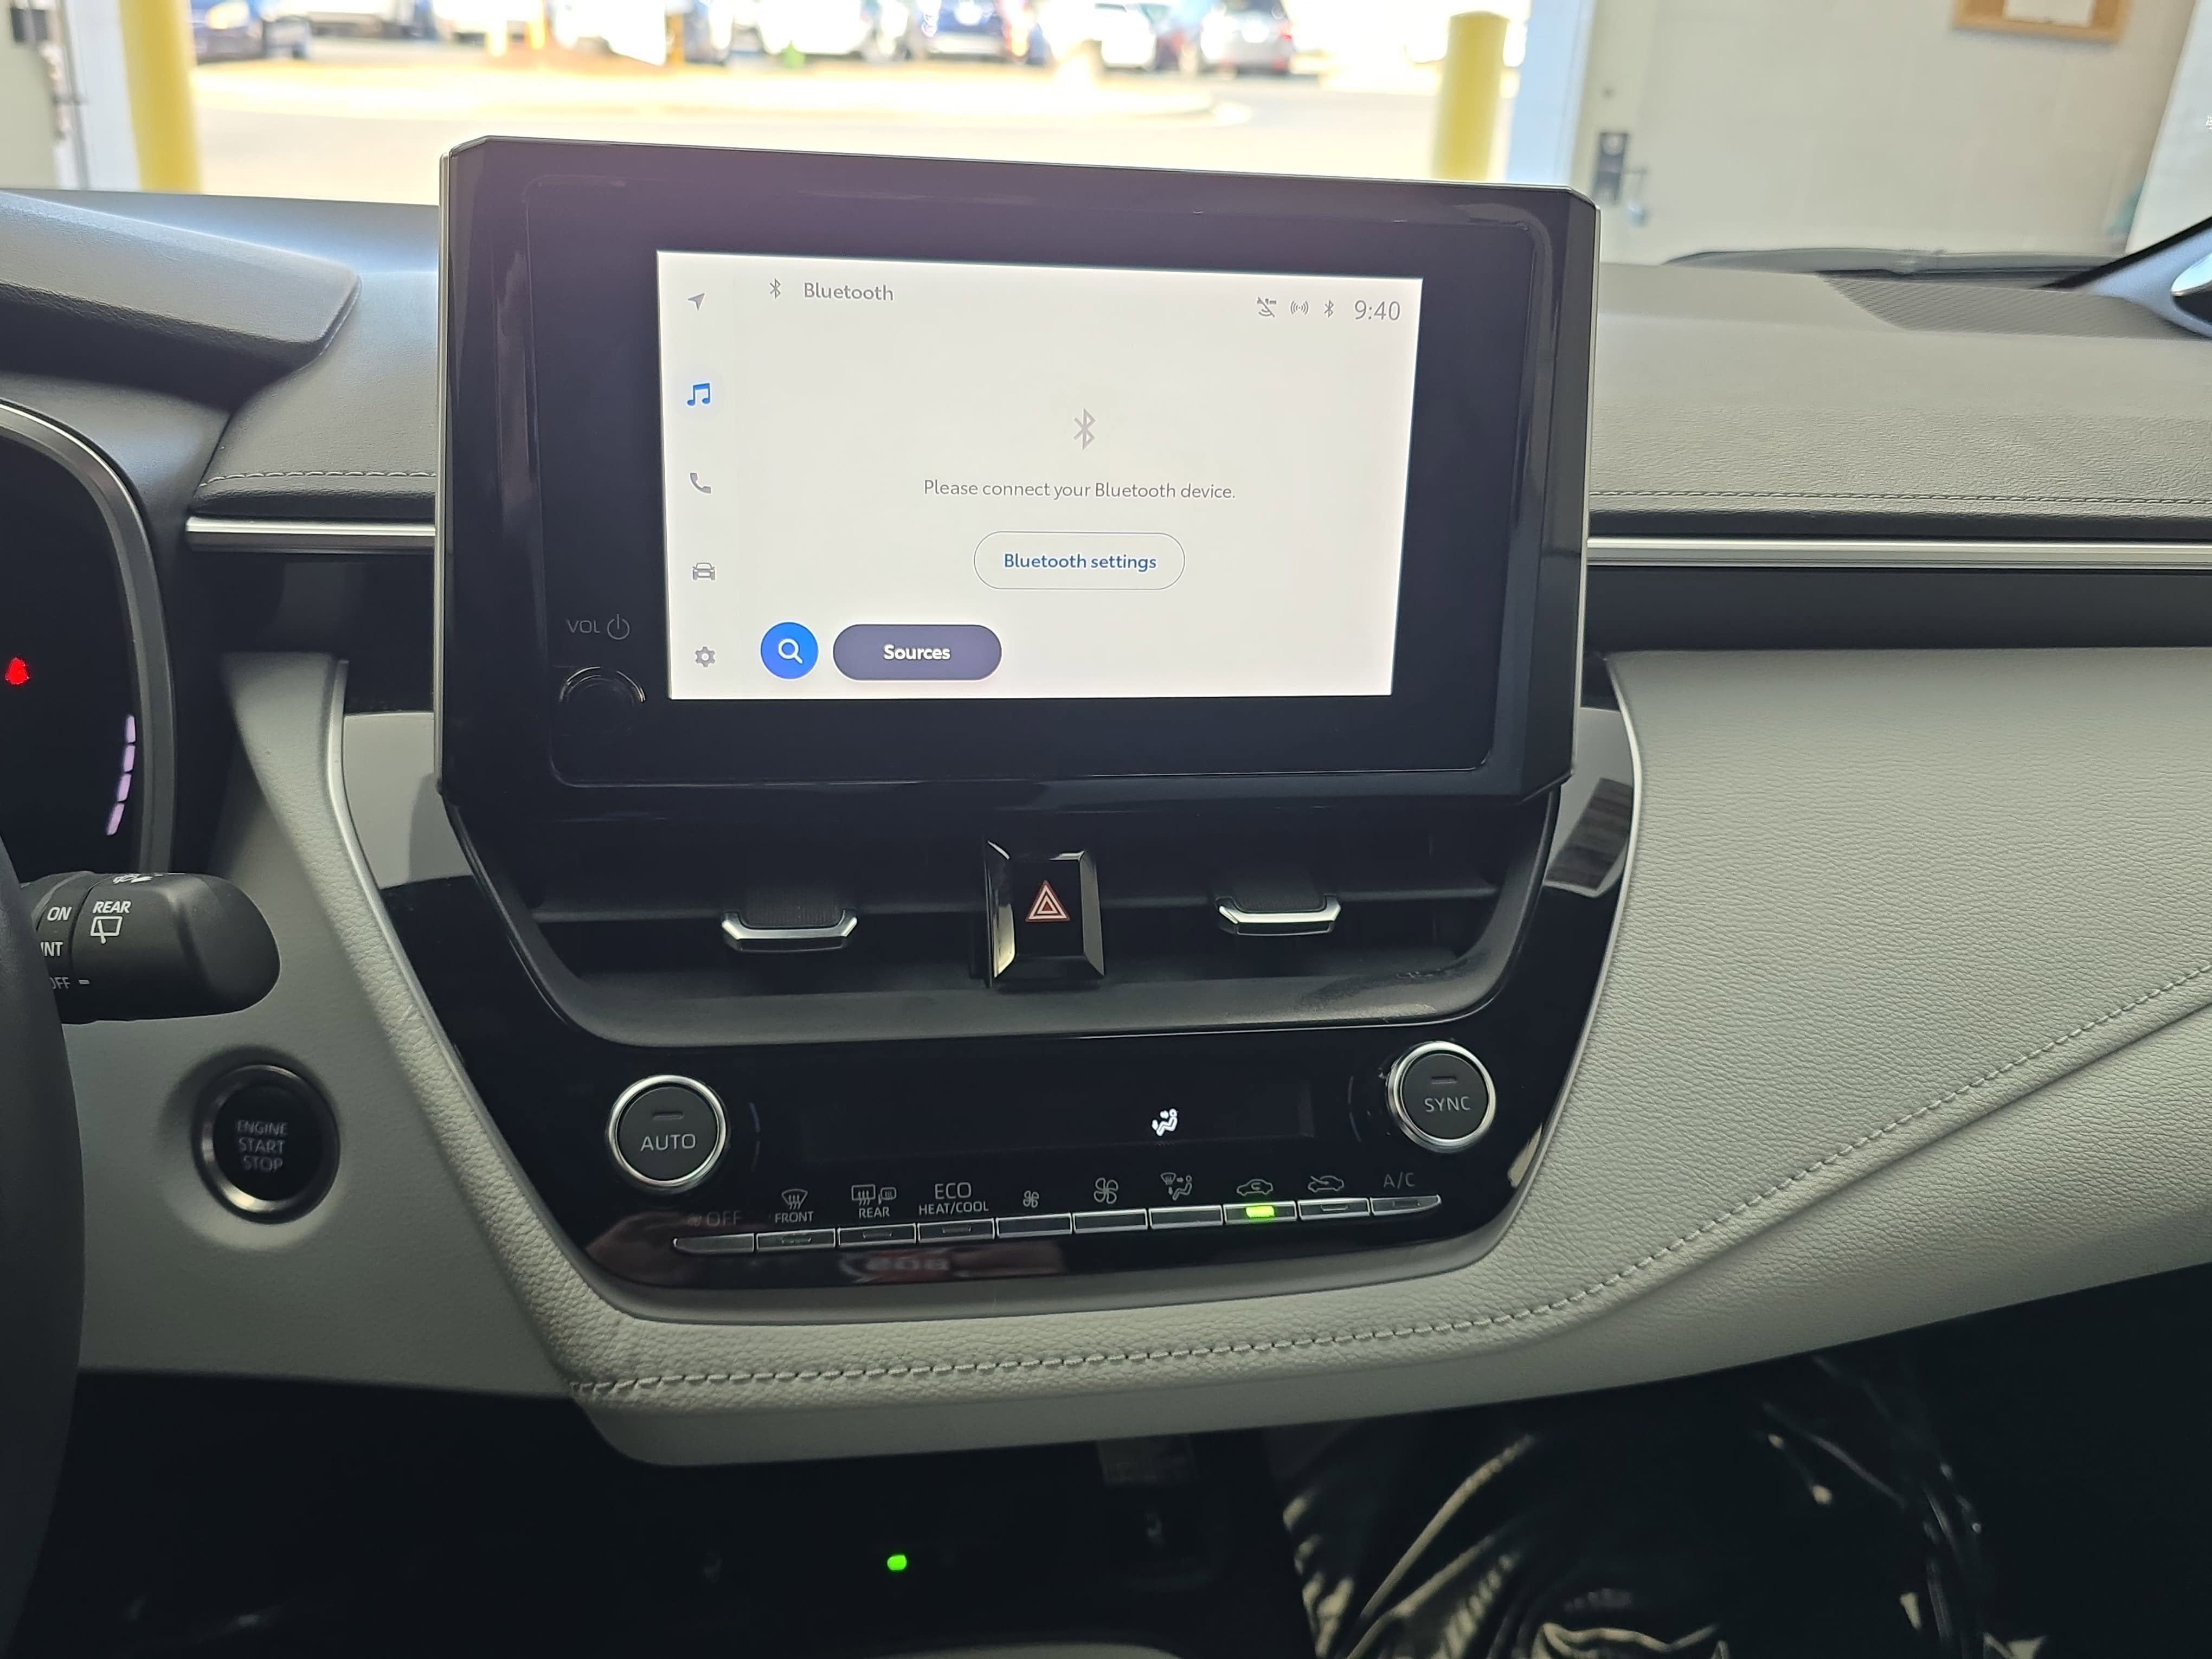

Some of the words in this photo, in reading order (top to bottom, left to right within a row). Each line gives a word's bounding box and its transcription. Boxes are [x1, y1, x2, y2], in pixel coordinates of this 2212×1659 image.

[804, 282, 893, 301] Bluetooth
[1354, 300, 1400, 320] 9:40
[924, 479, 978, 495] Please
[982, 483, 1050, 496] connect
[1053, 486, 1091, 500] your
[1095, 482, 1176, 498] Bluetooth
[1180, 483, 1235, 498] device.
[1005, 553, 1086, 568] Bluetooth
[1091, 554, 1156, 573] settings
[567, 620, 601, 633] VOL
[883, 644, 950, 660] Sources
[47, 906, 72, 921] ON
[92, 901, 131, 914] REAR
[1424, 1096, 1470, 1113] SYNC
[237, 1120, 289, 1136] ENGINE
[239, 1137, 284, 1153] START
[640, 1134, 696, 1152] AUTO
[243, 1155, 283, 1171] STOP
[1383, 1172, 1415, 1189] A/C
[935, 1182, 972, 1200] ECO
[859, 1206, 890, 1219] REAR
[919, 1201, 989, 1216] HEAT/COOL
[705, 1210, 743, 1227] OFF
[775, 1211, 814, 1224] FRONT
